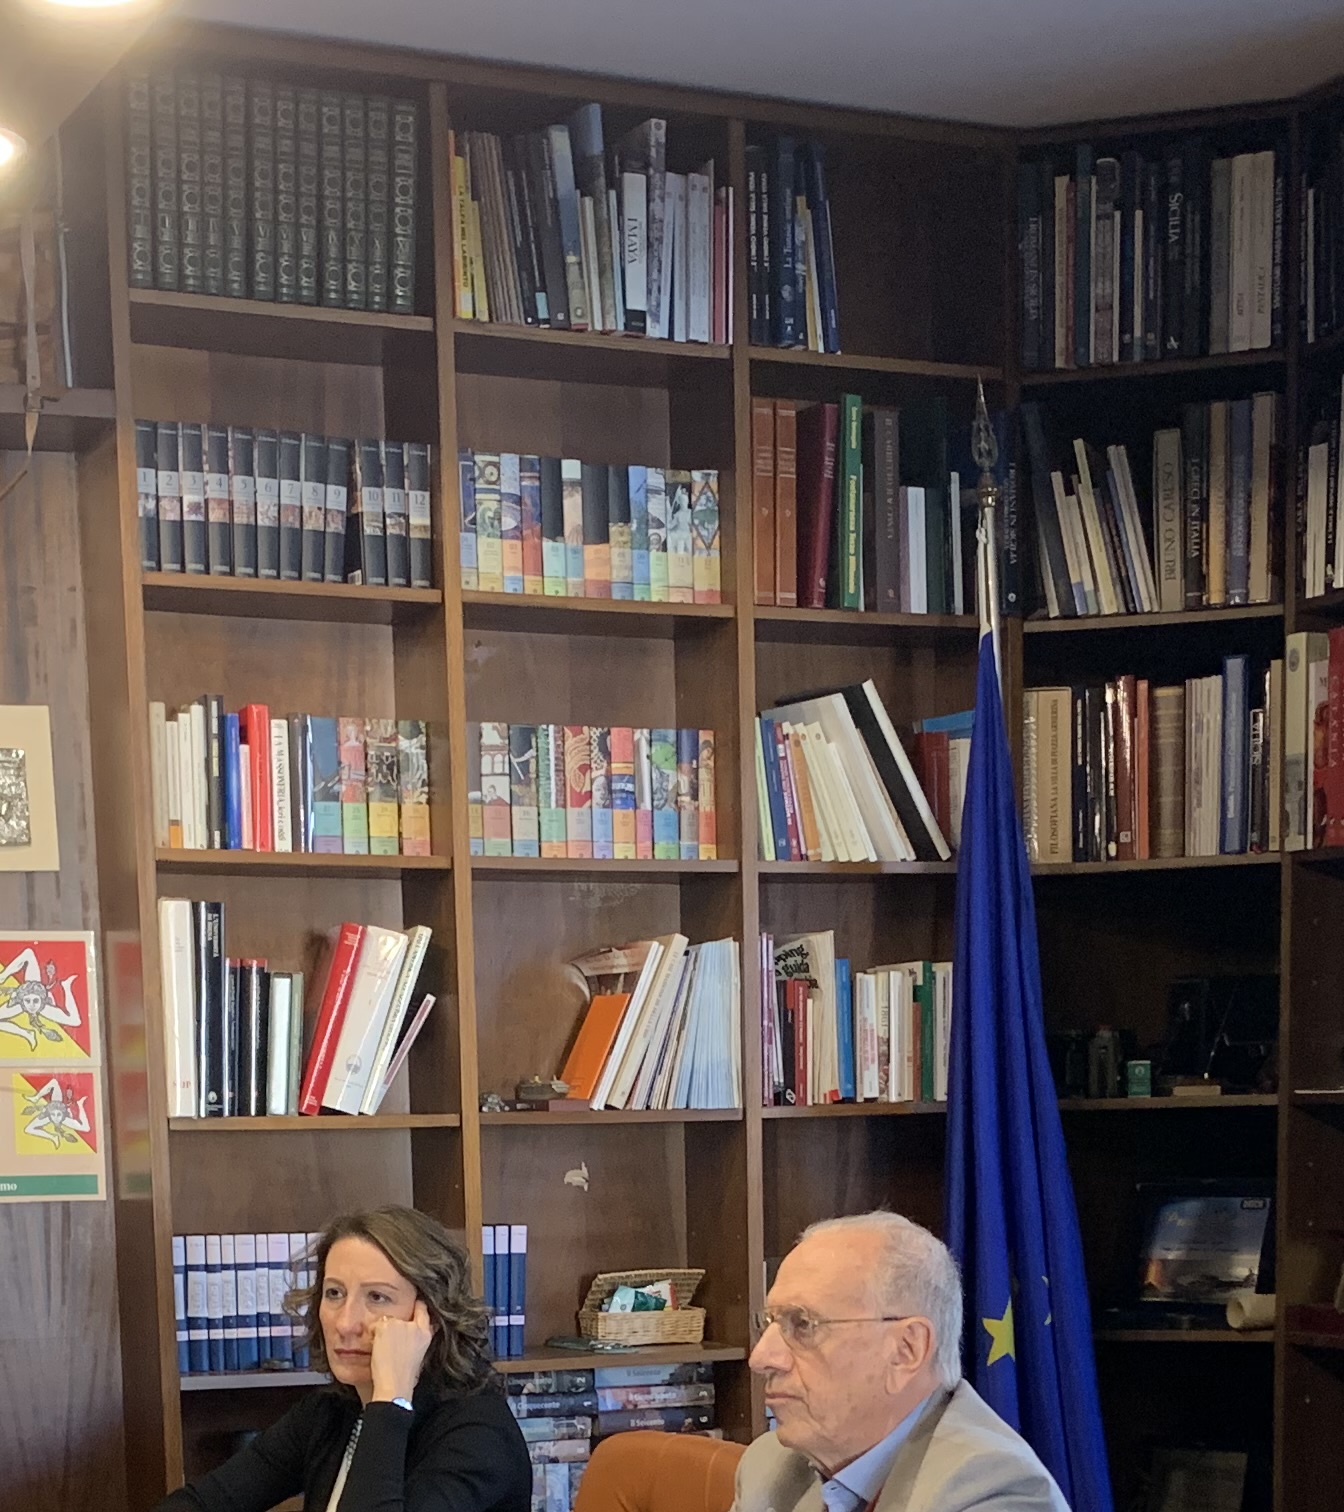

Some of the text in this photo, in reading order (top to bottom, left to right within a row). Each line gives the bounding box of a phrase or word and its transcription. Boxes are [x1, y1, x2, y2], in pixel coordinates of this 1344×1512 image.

[367, 489, 379, 501] 10
[414, 494, 426, 506] 12
[1163, 462, 1176, 581] BRUNO CARUSO
